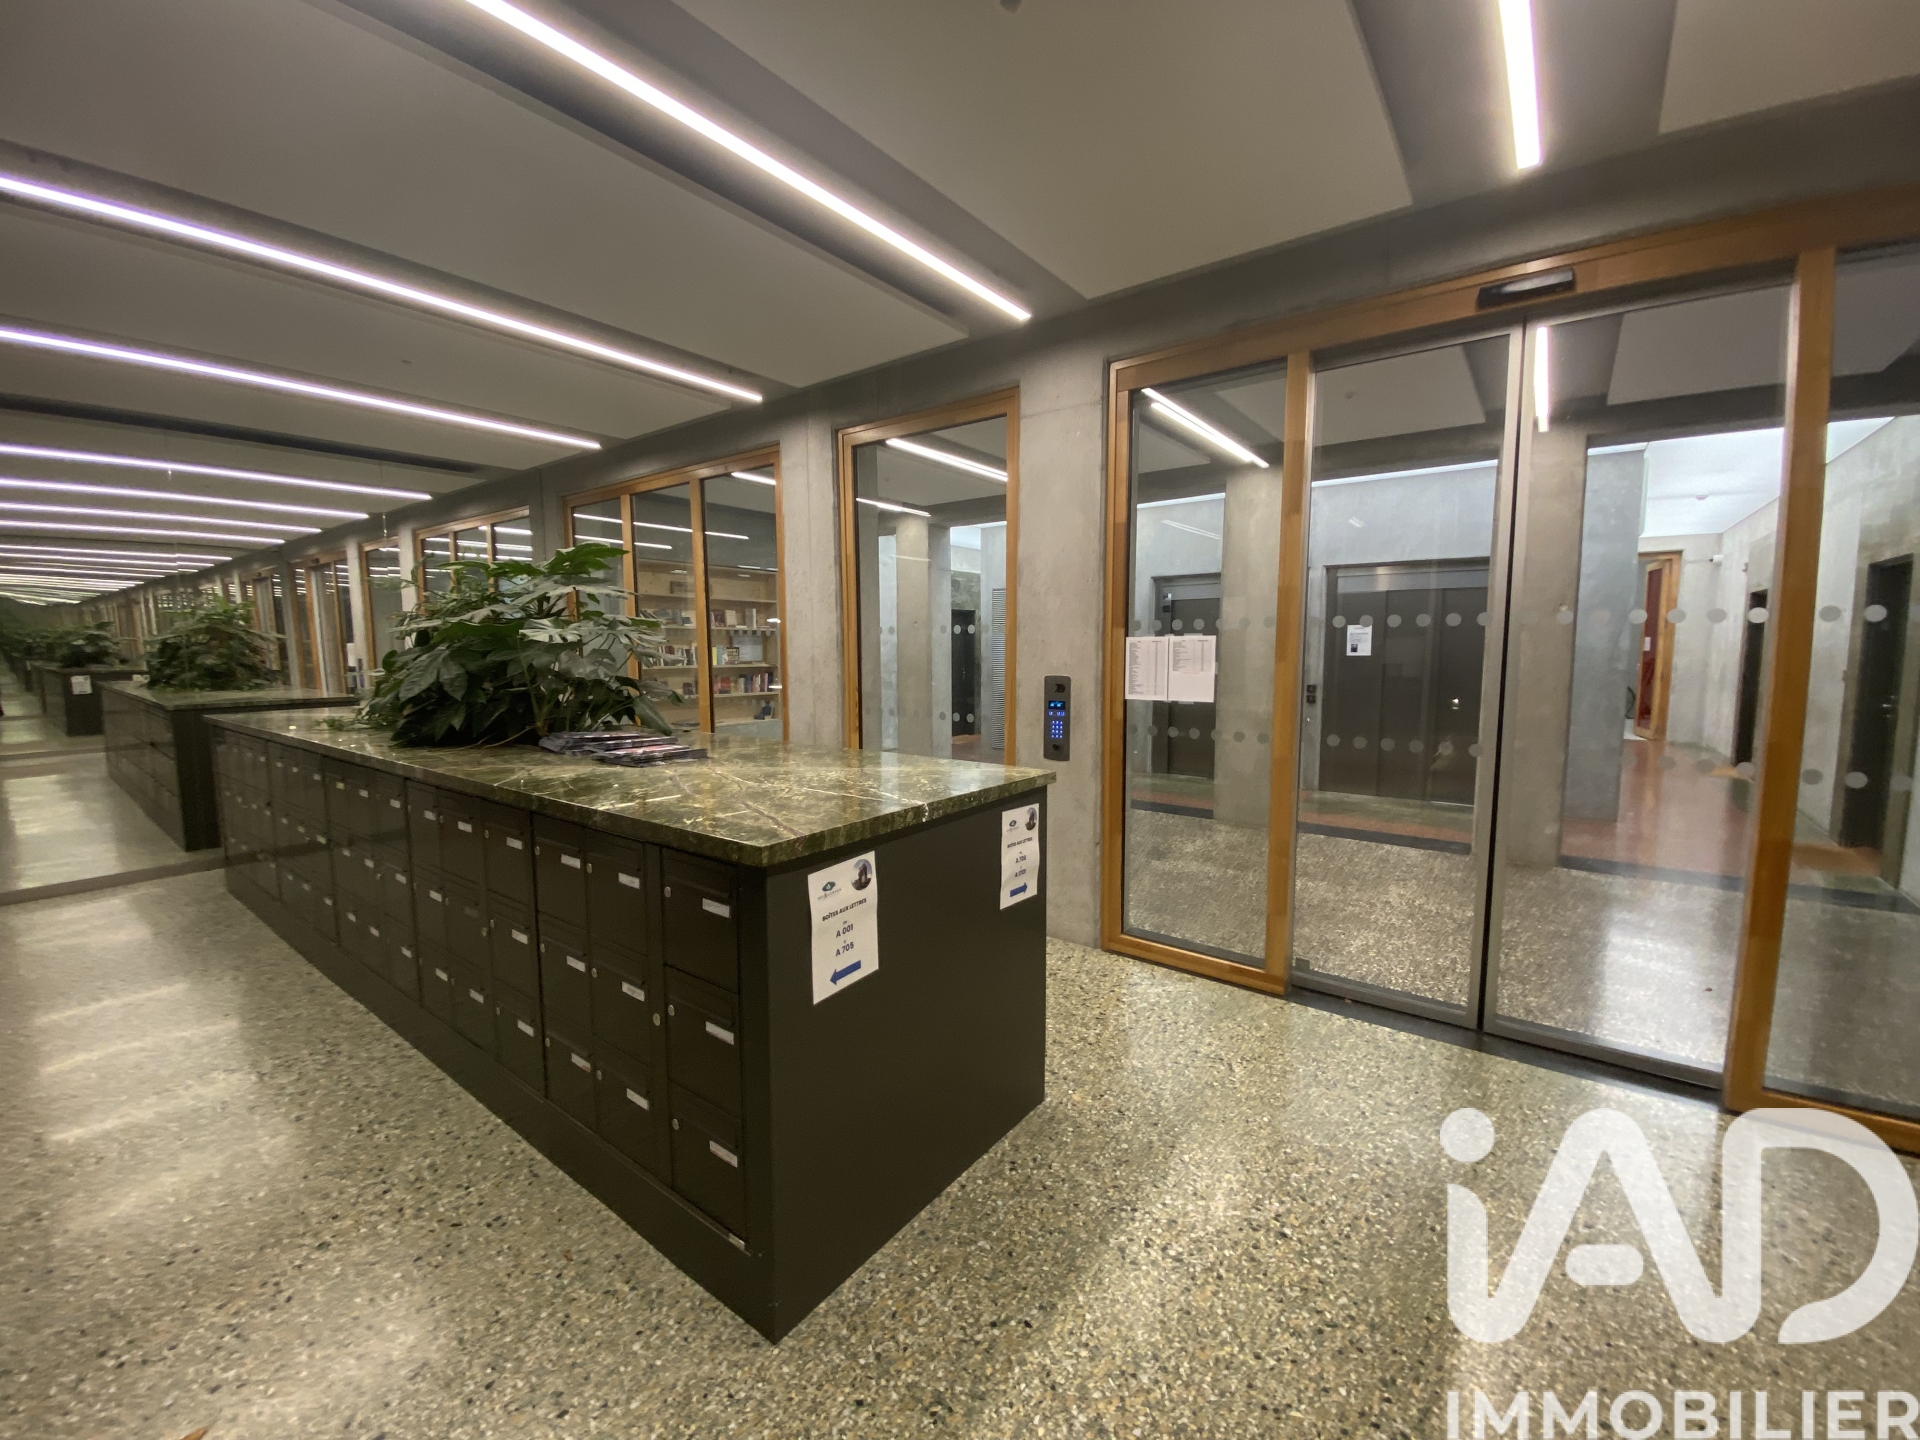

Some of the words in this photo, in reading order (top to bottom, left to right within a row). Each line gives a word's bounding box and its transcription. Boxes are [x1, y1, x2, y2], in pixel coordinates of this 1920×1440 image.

[839, 906, 849, 914] AUX
[850, 898, 867, 910] LETTRES
[836, 930, 841, 938] A
[842, 924, 853, 934] 001
[836, 949, 841, 957] A
[842, 942, 854, 953] 705
